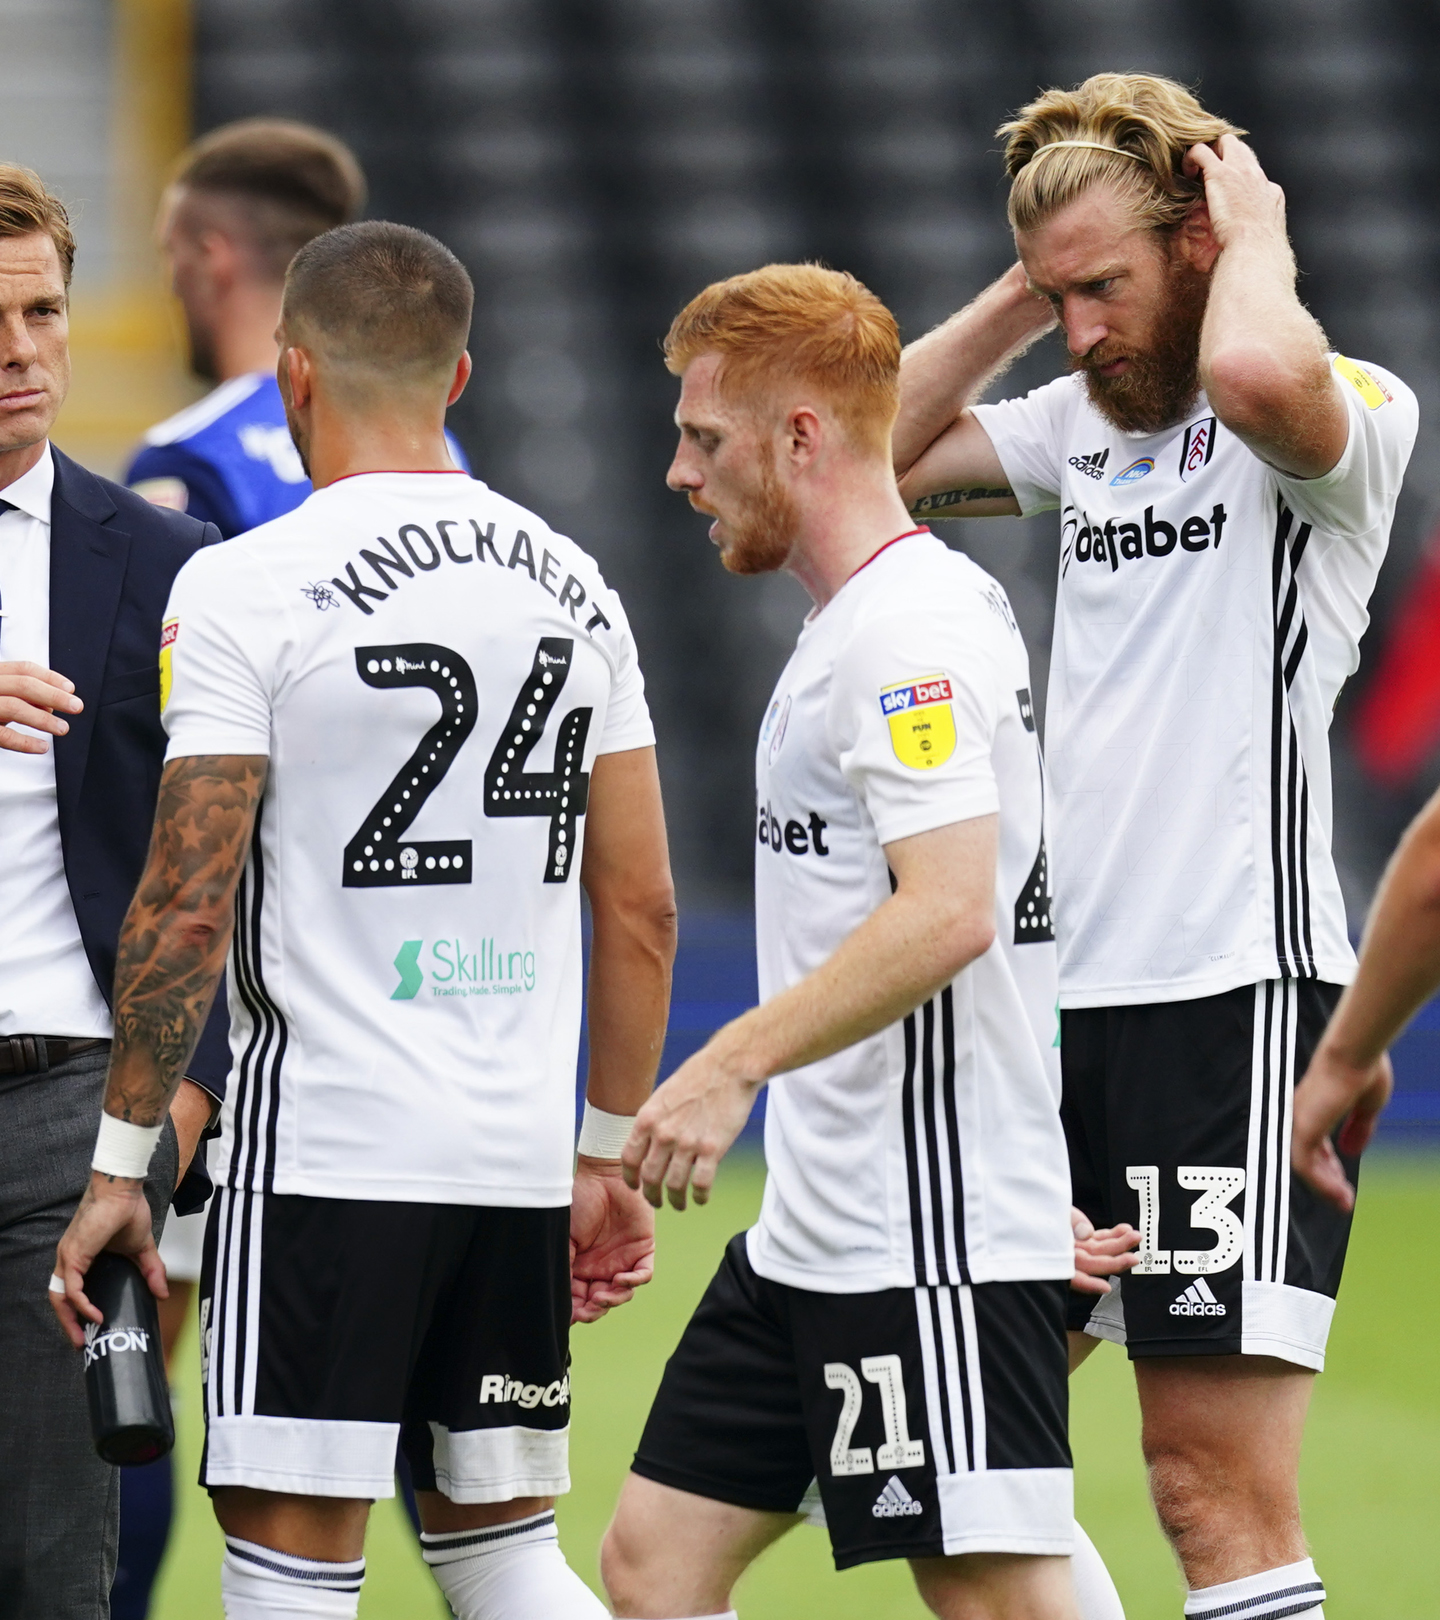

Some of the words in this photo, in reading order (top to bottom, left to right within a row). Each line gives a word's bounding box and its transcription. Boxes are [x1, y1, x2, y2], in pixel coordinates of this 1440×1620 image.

[1068, 456, 1105, 481] adidas
[1075, 502, 1228, 573] dafabet
[331, 518, 611, 639] KNOCKAERT
[882, 689, 912, 713] sky
[915, 681, 950, 702] bet
[342, 636, 594, 888] 24
[401, 869, 418, 880] EFL
[431, 936, 536, 992] Skilling
[1126, 1165, 1246, 1275] 13
[1169, 1301, 1227, 1316] adidas
[824, 1354, 926, 1477] 21
[872, 1500, 923, 1518] adidas
